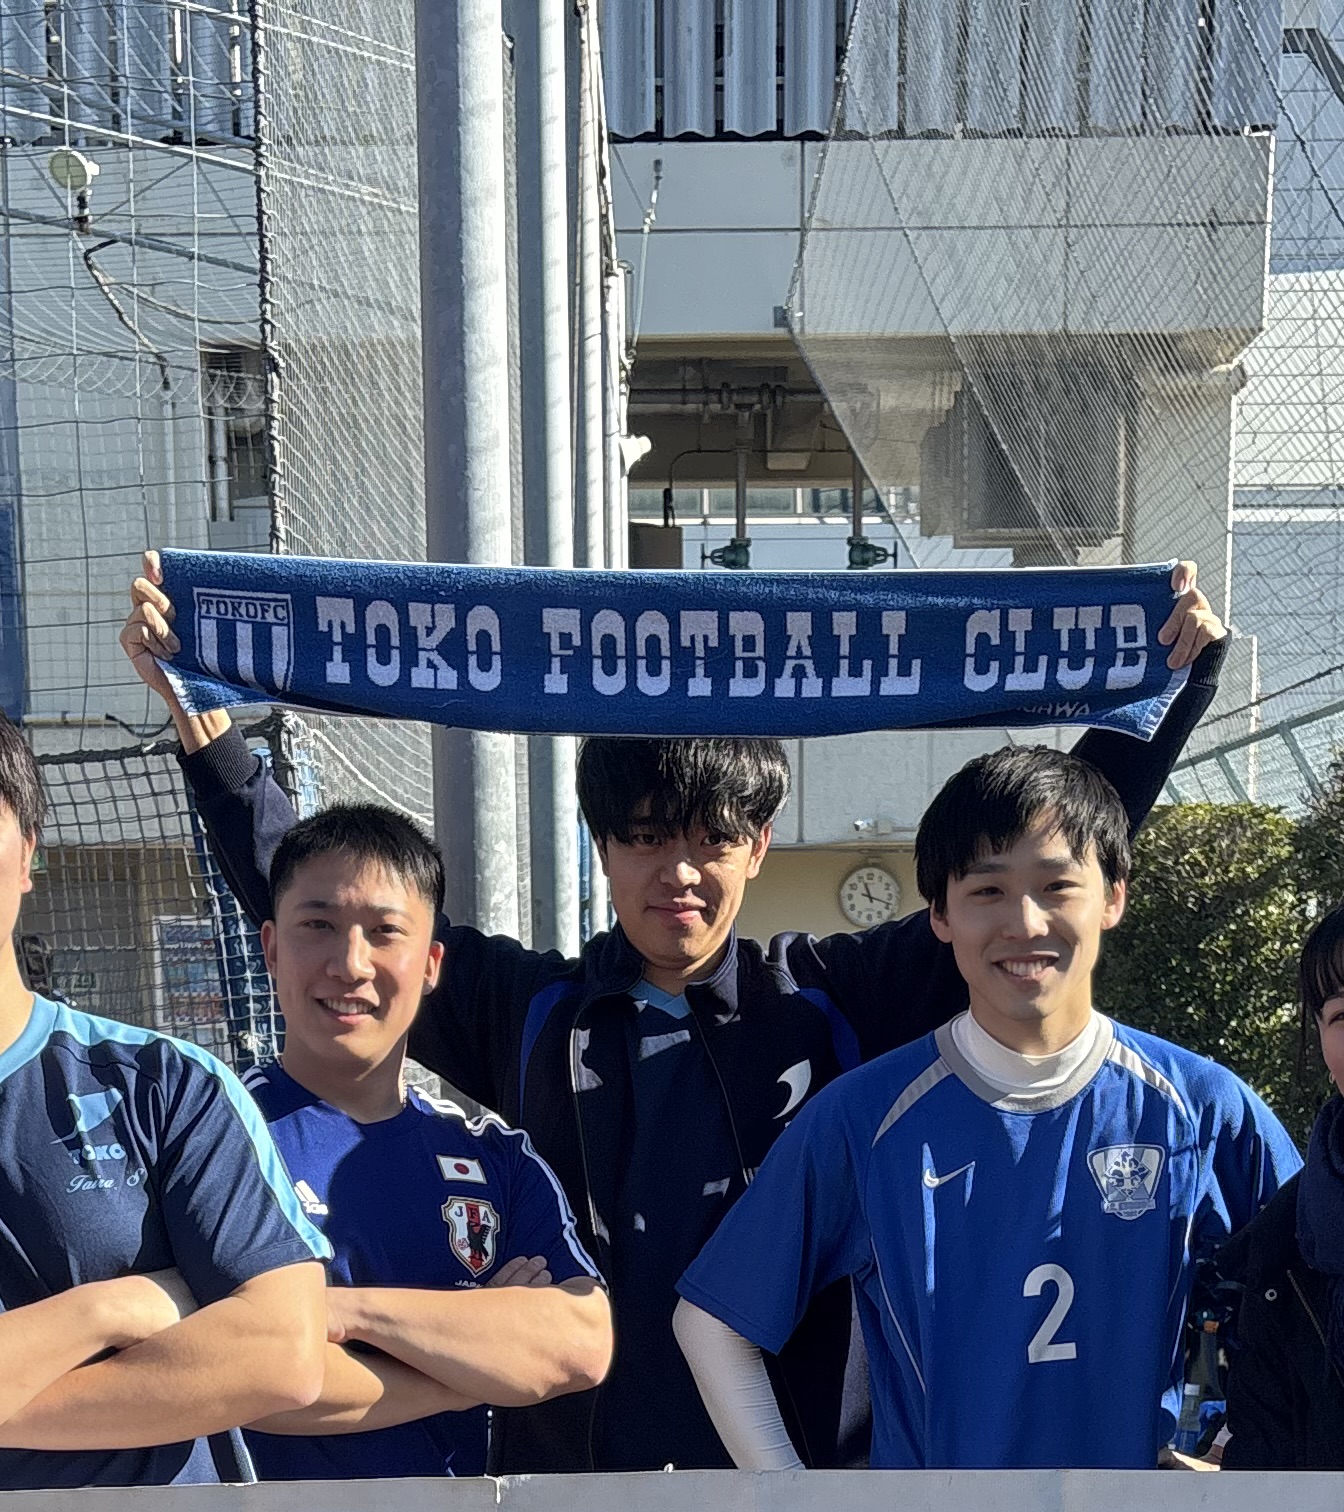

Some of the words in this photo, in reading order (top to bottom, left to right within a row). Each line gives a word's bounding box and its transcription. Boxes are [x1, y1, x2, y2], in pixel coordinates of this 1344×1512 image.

[200, 599, 287, 623] TOKOFC
[315, 595, 503, 692] TOKO
[541, 607, 921, 698] FOOTBALL
[962, 603, 1148, 692] CLUB
[454, 1205, 492, 1224] JFA
[1022, 1263, 1078, 1364] 2
